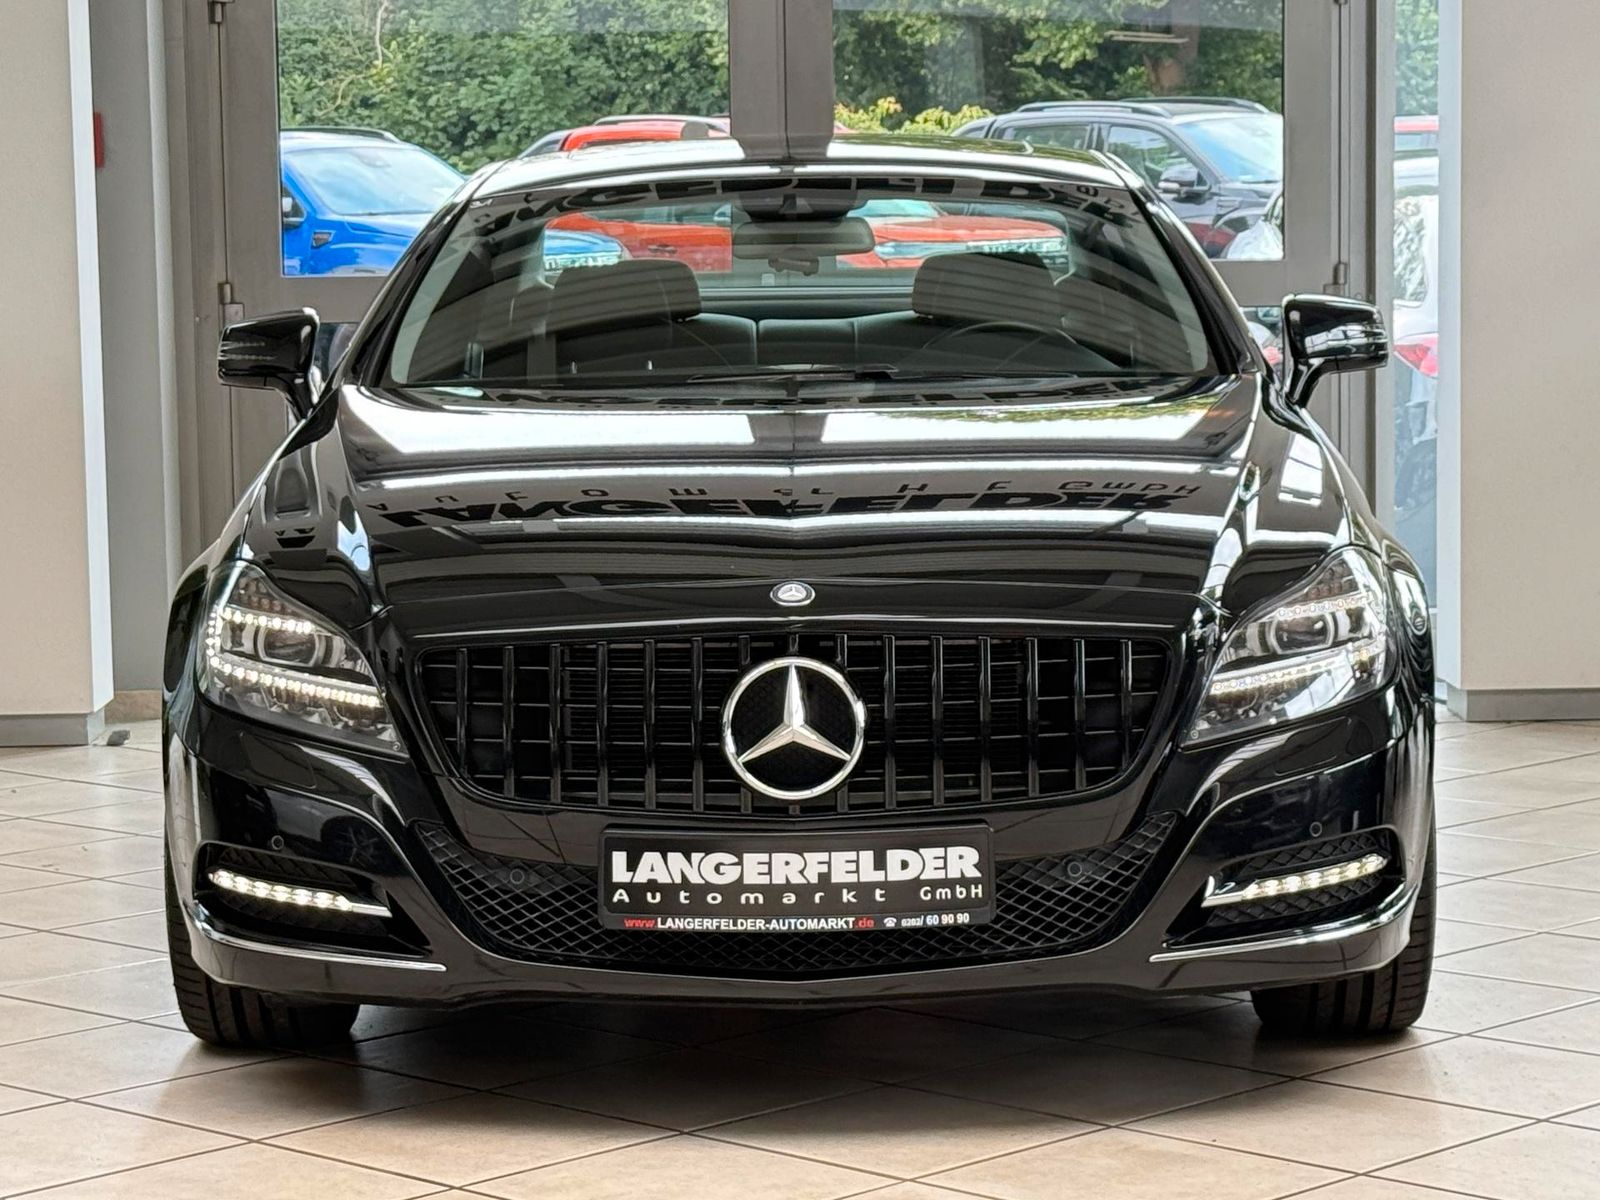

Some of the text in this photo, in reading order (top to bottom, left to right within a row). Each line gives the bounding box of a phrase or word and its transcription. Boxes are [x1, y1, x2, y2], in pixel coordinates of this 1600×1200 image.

[611, 845, 982, 885] LANGERFELDER
[612, 883, 983, 905] Automarkt GmbH
[624, 917, 875, 931] www.LANGERFELDER-AUTOMARKT.de
[926, 914, 939, 925] 60
[941, 913, 955, 924] 90
[956, 912, 970, 923] 90
